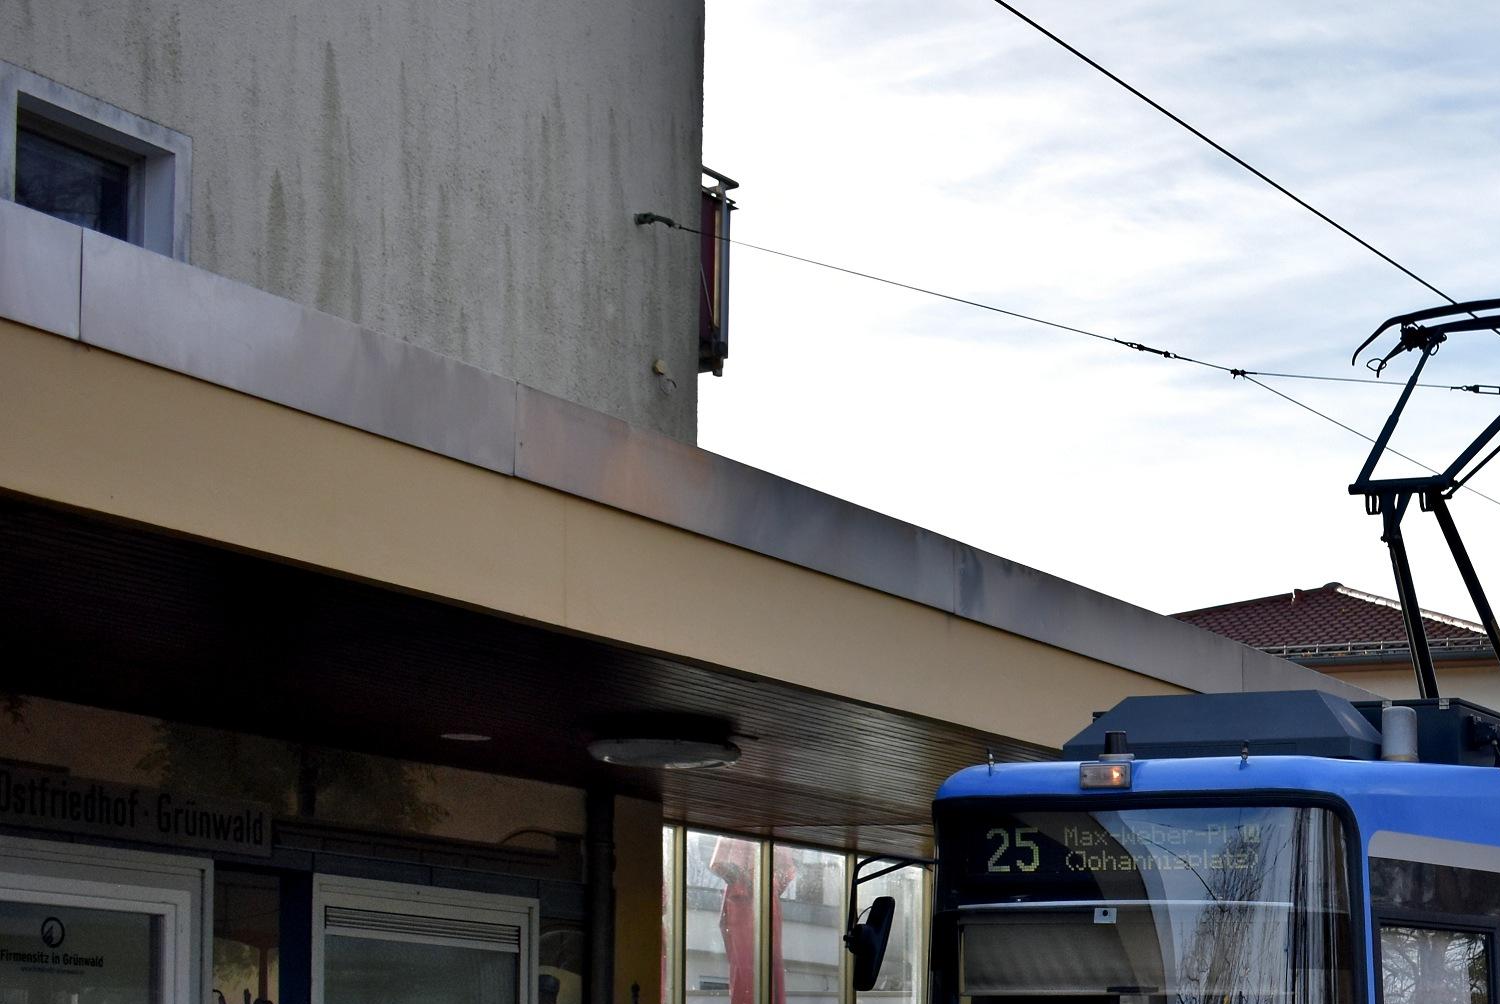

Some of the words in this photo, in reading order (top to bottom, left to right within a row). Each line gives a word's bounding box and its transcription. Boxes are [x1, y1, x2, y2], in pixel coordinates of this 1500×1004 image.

[158, 793, 263, 845] Grünwald
[986, 827, 1040, 873] 25
[0, 949, 49, 964] Firmensitz
[52, 951, 60, 964] in
[63, 953, 104, 968] Grünwald
